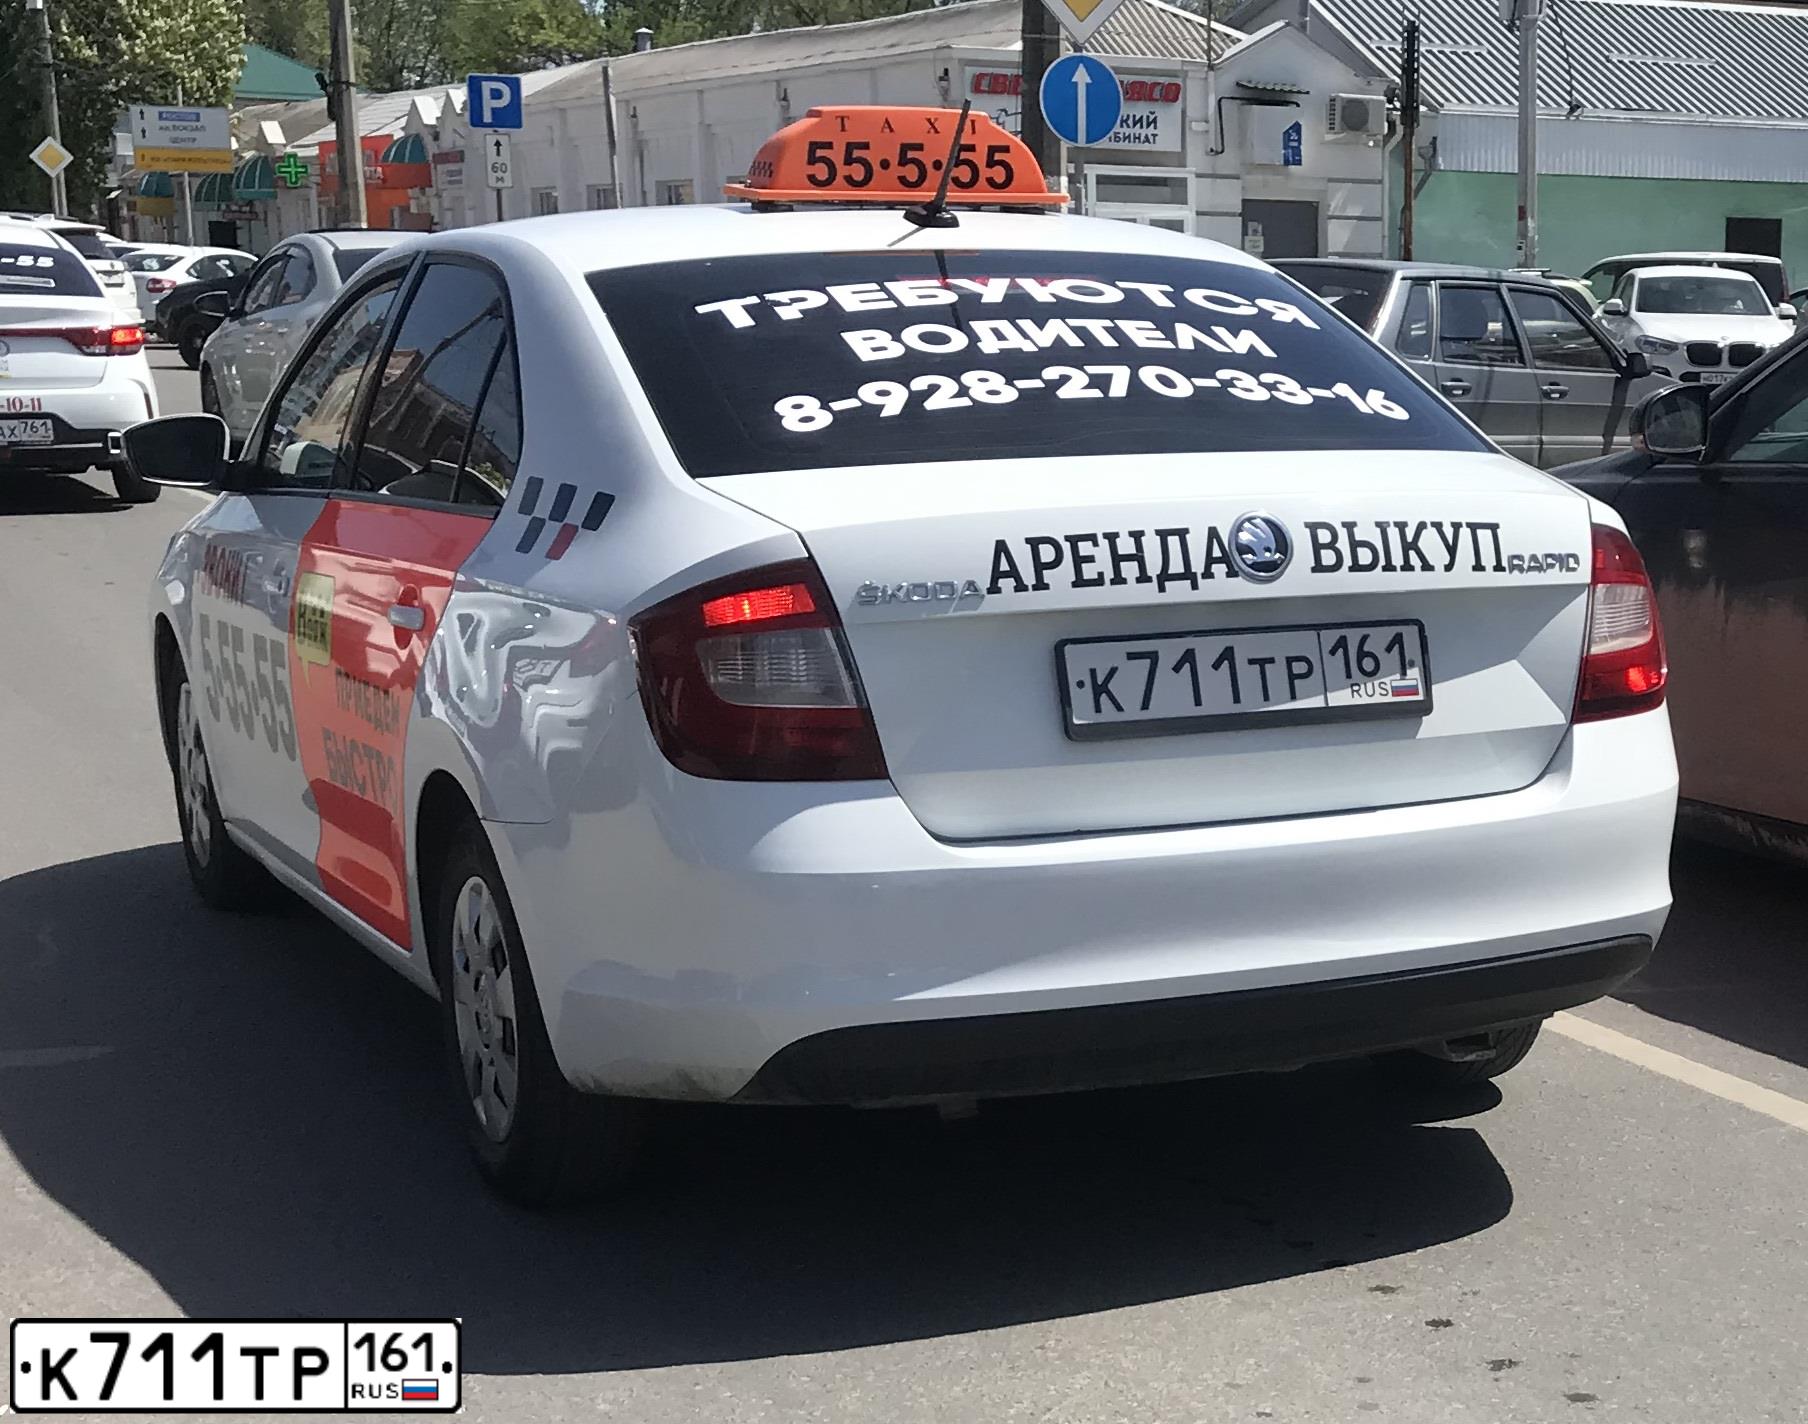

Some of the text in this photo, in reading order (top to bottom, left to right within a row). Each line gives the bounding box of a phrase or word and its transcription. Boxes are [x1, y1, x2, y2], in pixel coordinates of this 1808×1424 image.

[481, 81, 511, 123] P
[491, 162, 508, 174] 60
[695, 277, 1322, 331] ТРЕБУЮТСЯ
[840, 317, 1280, 363] ВОДИТЕЛИ
[773, 364, 1411, 434] 8-928-270-33-16
[20, 420, 48, 434] 761
[985, 526, 1240, 595] АРЕНДА
[1305, 520, 1507, 574] ВЫКУП
[1507, 552, 1580, 575] RAPID
[1089, 631, 1408, 714] К711ТР 161
[1350, 681, 1390, 699] RUS
